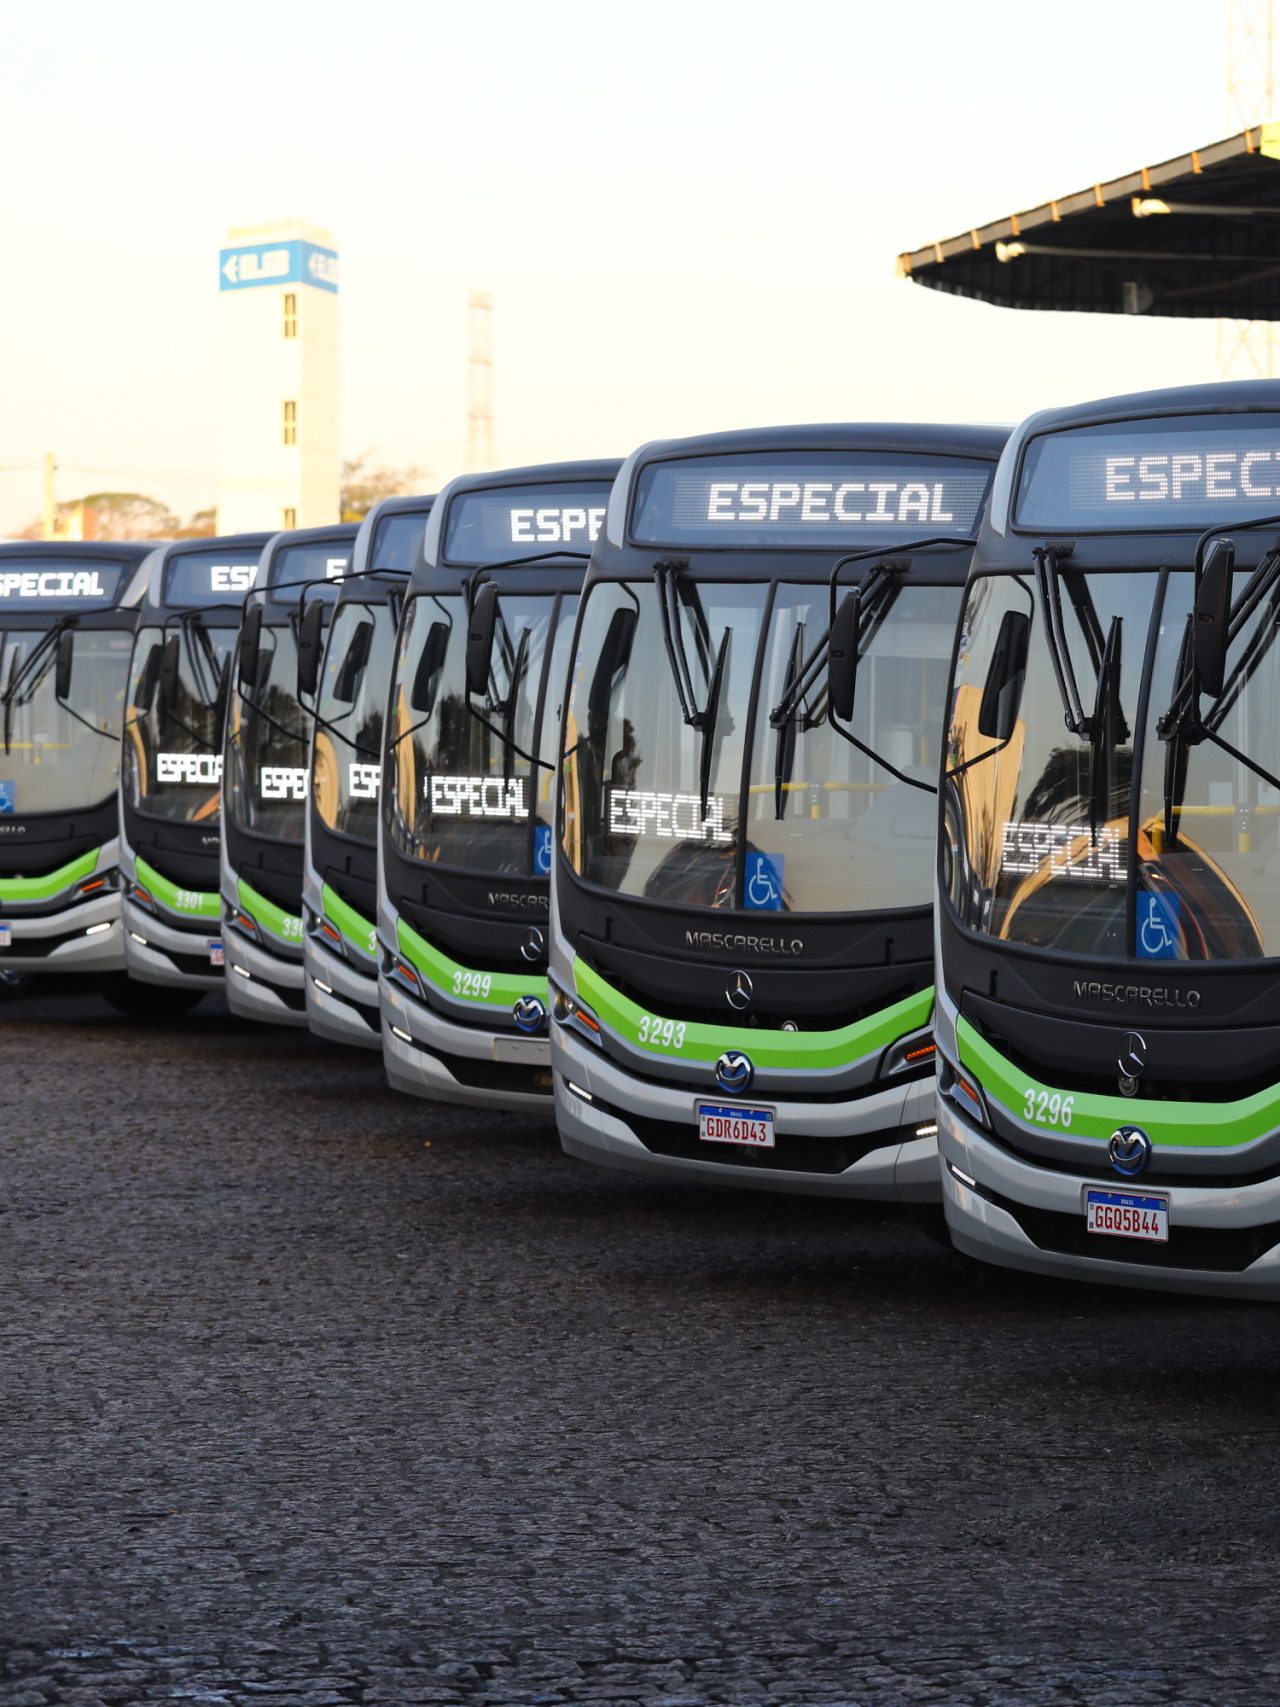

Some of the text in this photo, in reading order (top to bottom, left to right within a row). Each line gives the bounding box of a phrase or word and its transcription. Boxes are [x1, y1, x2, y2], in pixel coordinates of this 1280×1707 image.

[707, 483, 954, 521] ESPECIAL
[0, 572, 104, 597] PECIAL
[431, 775, 529, 817] ESPECIAL
[610, 789, 733, 841] ESPECIAL
[1002, 822, 1128, 879] ESPECIAL
[685, 930, 804, 955] MASCARELLO
[453, 971, 491, 998] 3299
[1073, 980, 1201, 1008] MASCARELLO
[638, 1016, 687, 1049] 3293
[1023, 1088, 1075, 1128] 3296
[706, 1117, 767, 1142] GDR6D43
[1095, 1205, 1159, 1235] GGQ5B44
